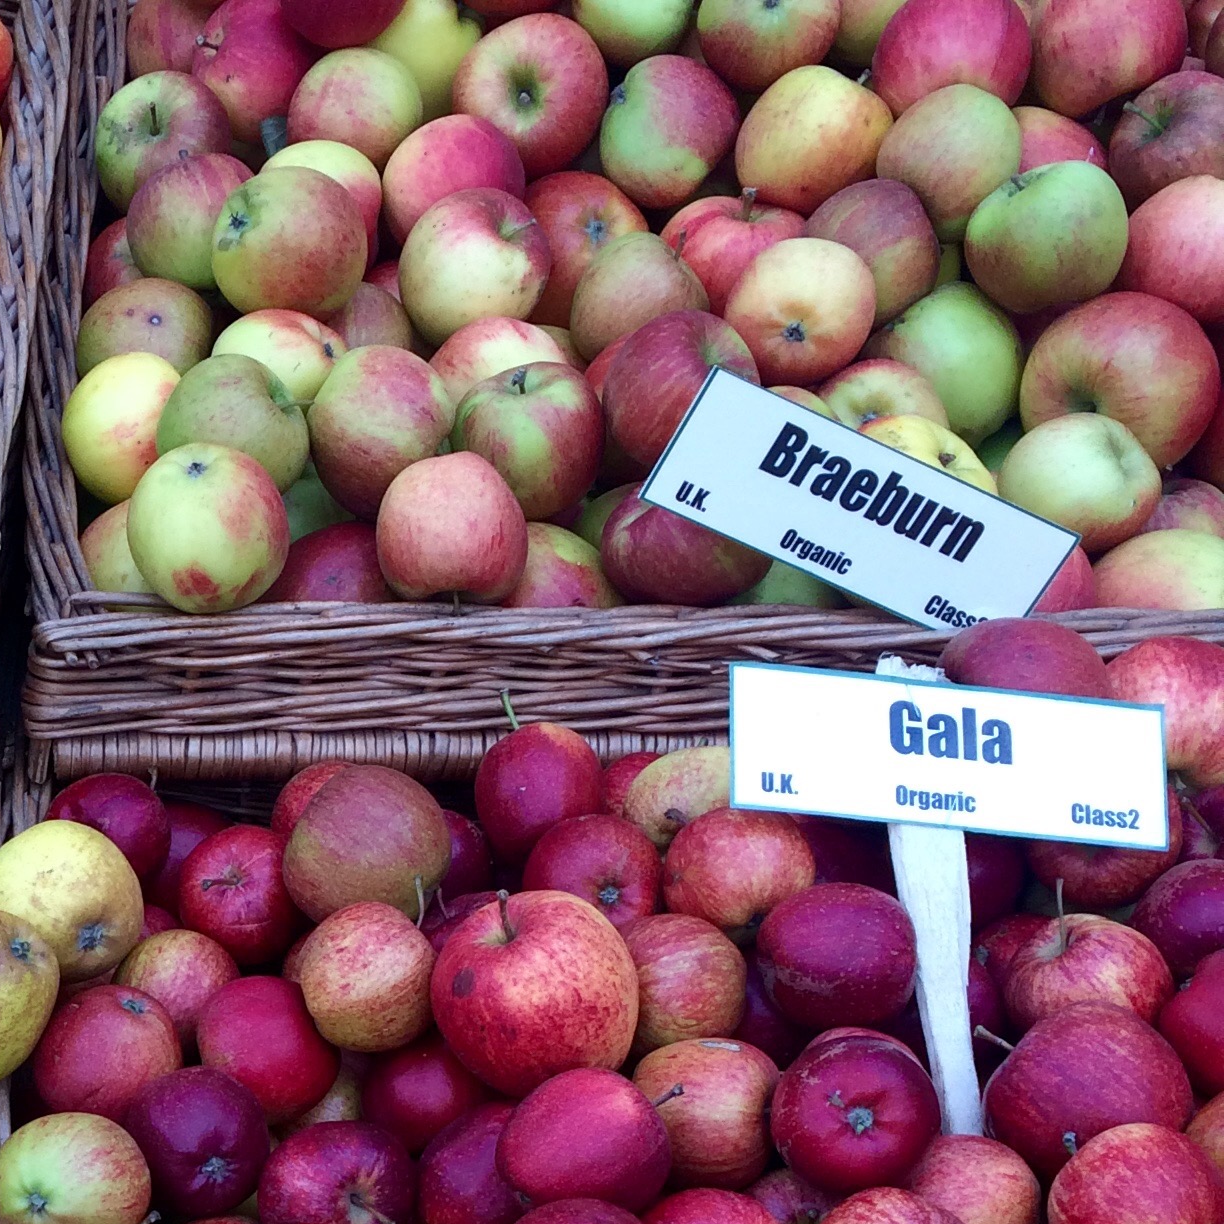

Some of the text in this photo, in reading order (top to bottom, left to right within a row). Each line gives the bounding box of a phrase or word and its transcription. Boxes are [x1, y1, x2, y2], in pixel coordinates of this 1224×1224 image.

[759, 422, 984, 562] Braeburn
[676, 481, 989, 628] U.K. Organic Class
[889, 701, 1012, 764] Gala
[761, 771, 1139, 829] U.K. Organic Class2
